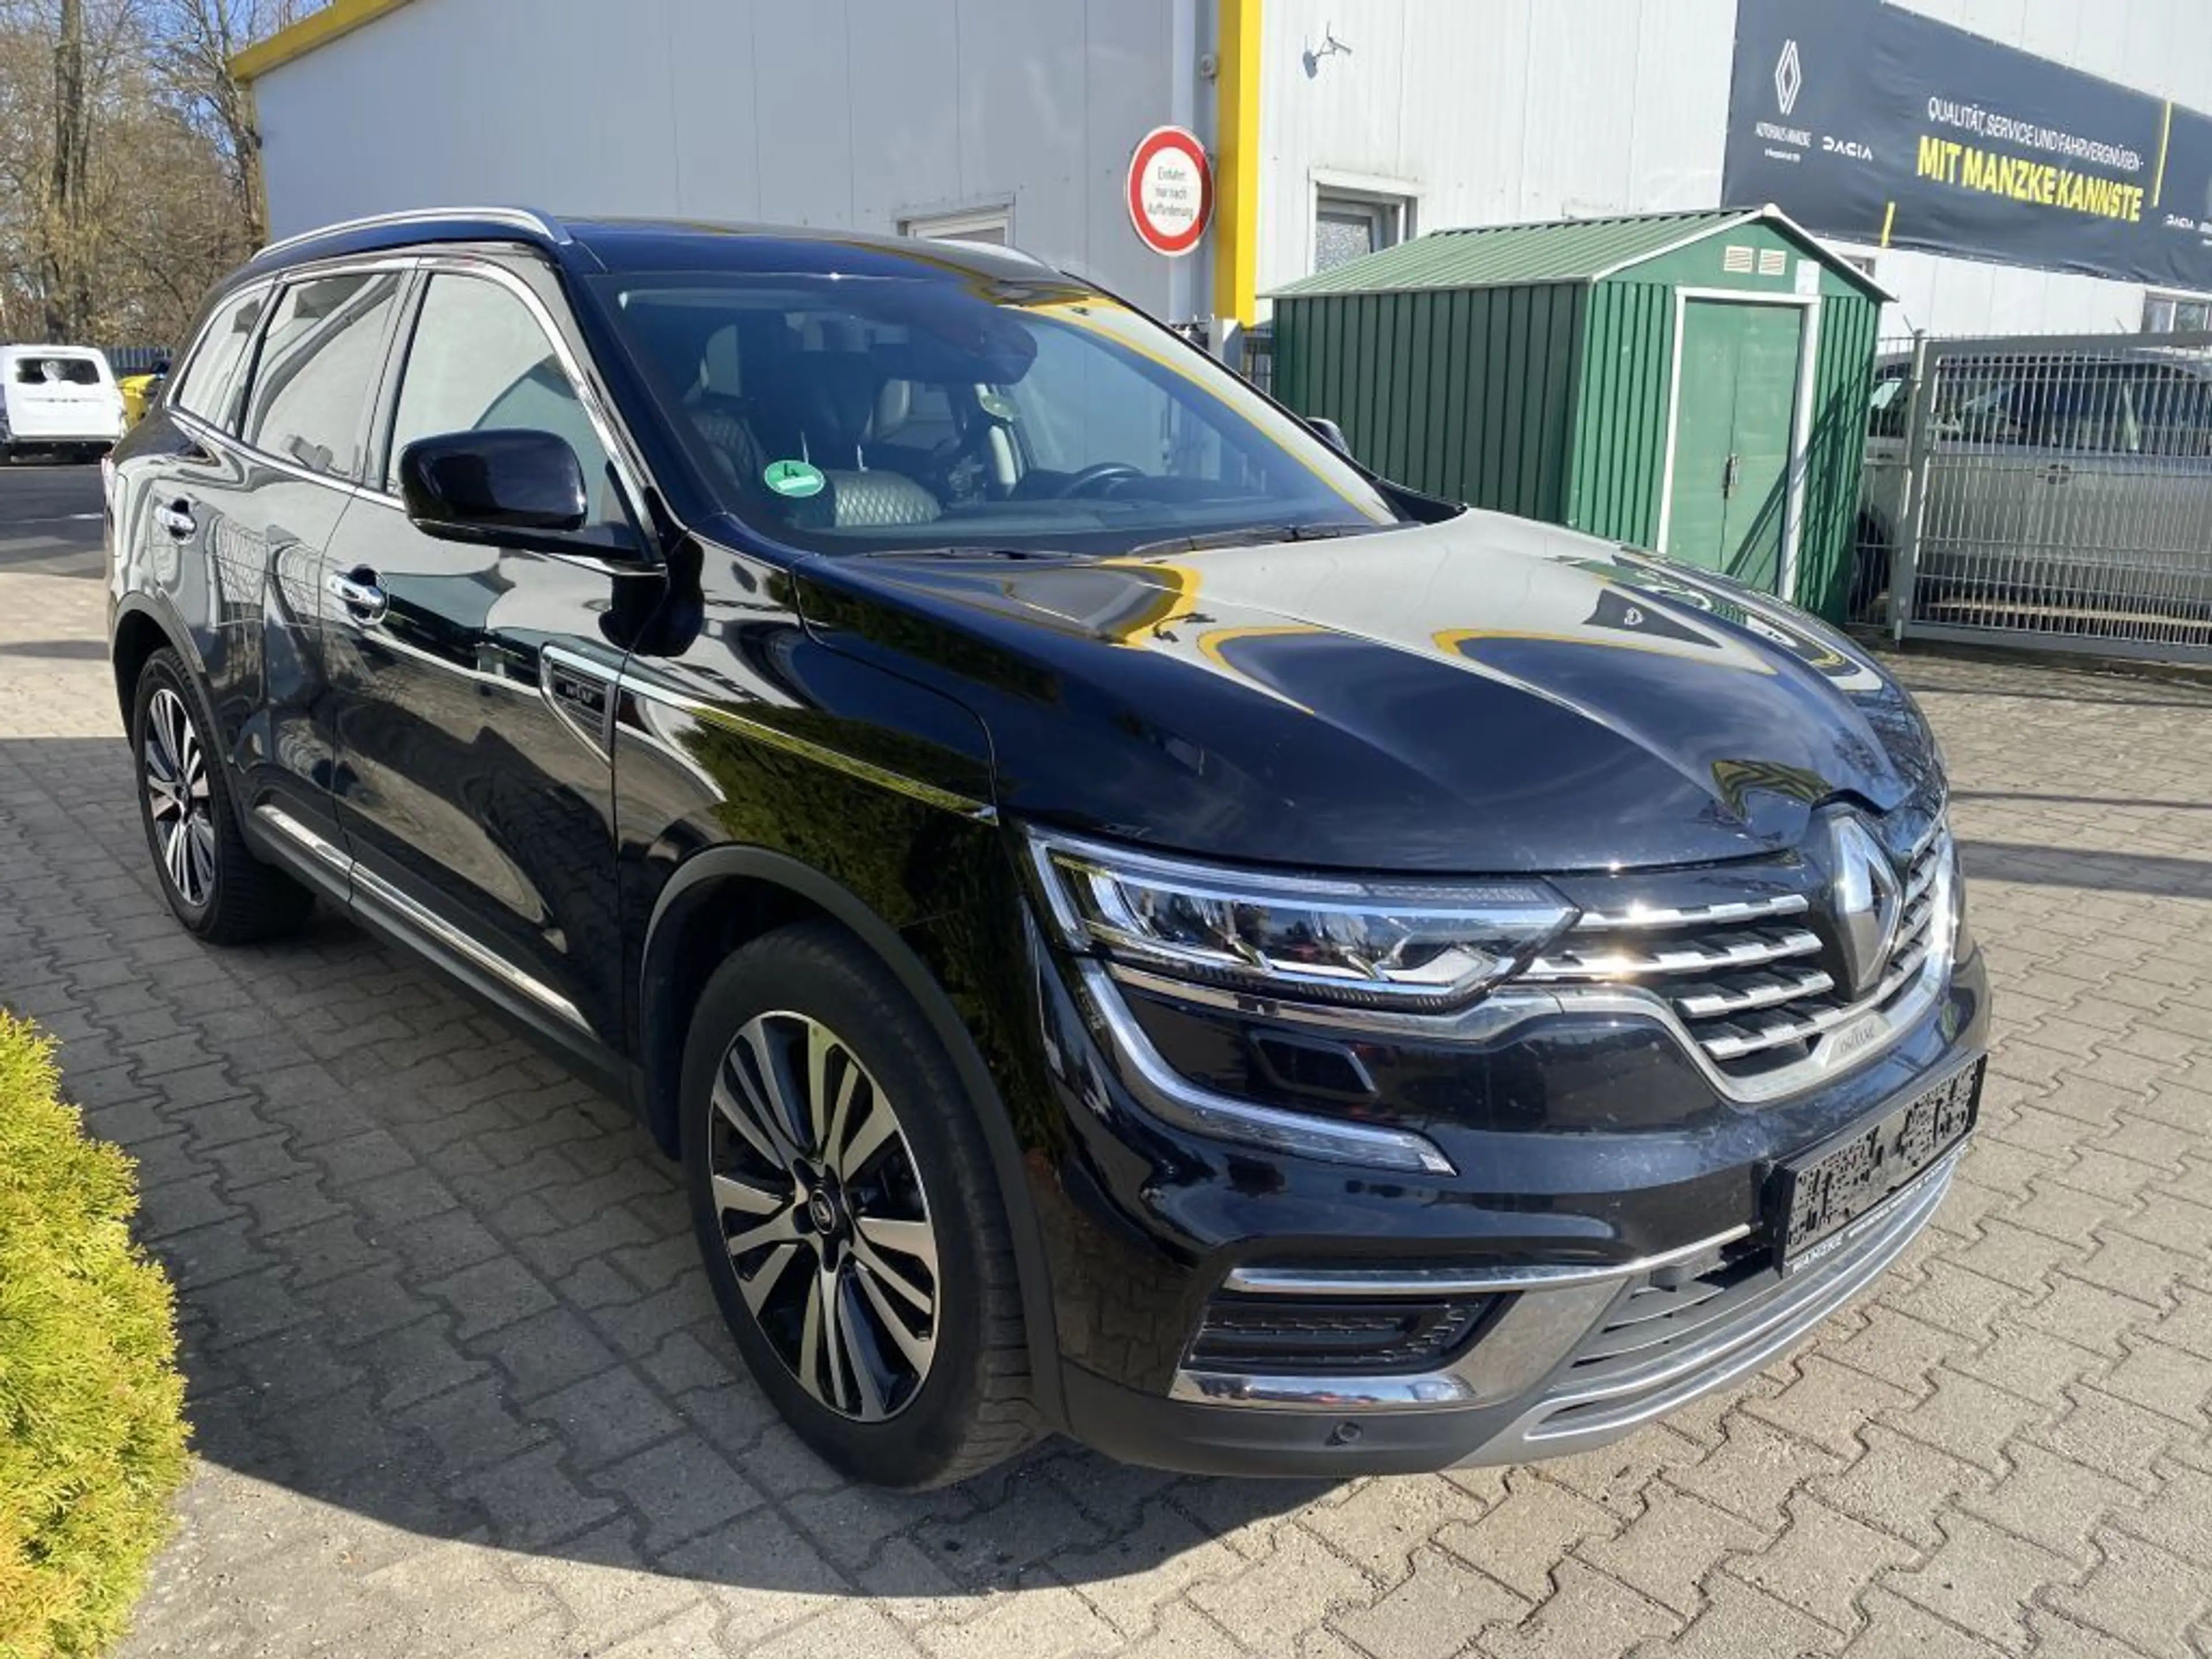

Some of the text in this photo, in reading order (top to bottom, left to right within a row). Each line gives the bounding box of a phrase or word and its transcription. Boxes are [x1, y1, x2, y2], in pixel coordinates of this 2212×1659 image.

[1822, 135, 1873, 161] DACIA
[1929, 96, 1987, 137] QUALITÄT,
[1987, 114, 2034, 145] SERVICE
[2034, 127, 2058, 151] UND
[1917, 135, 2144, 222] MIT MANZKE KANNSTE
